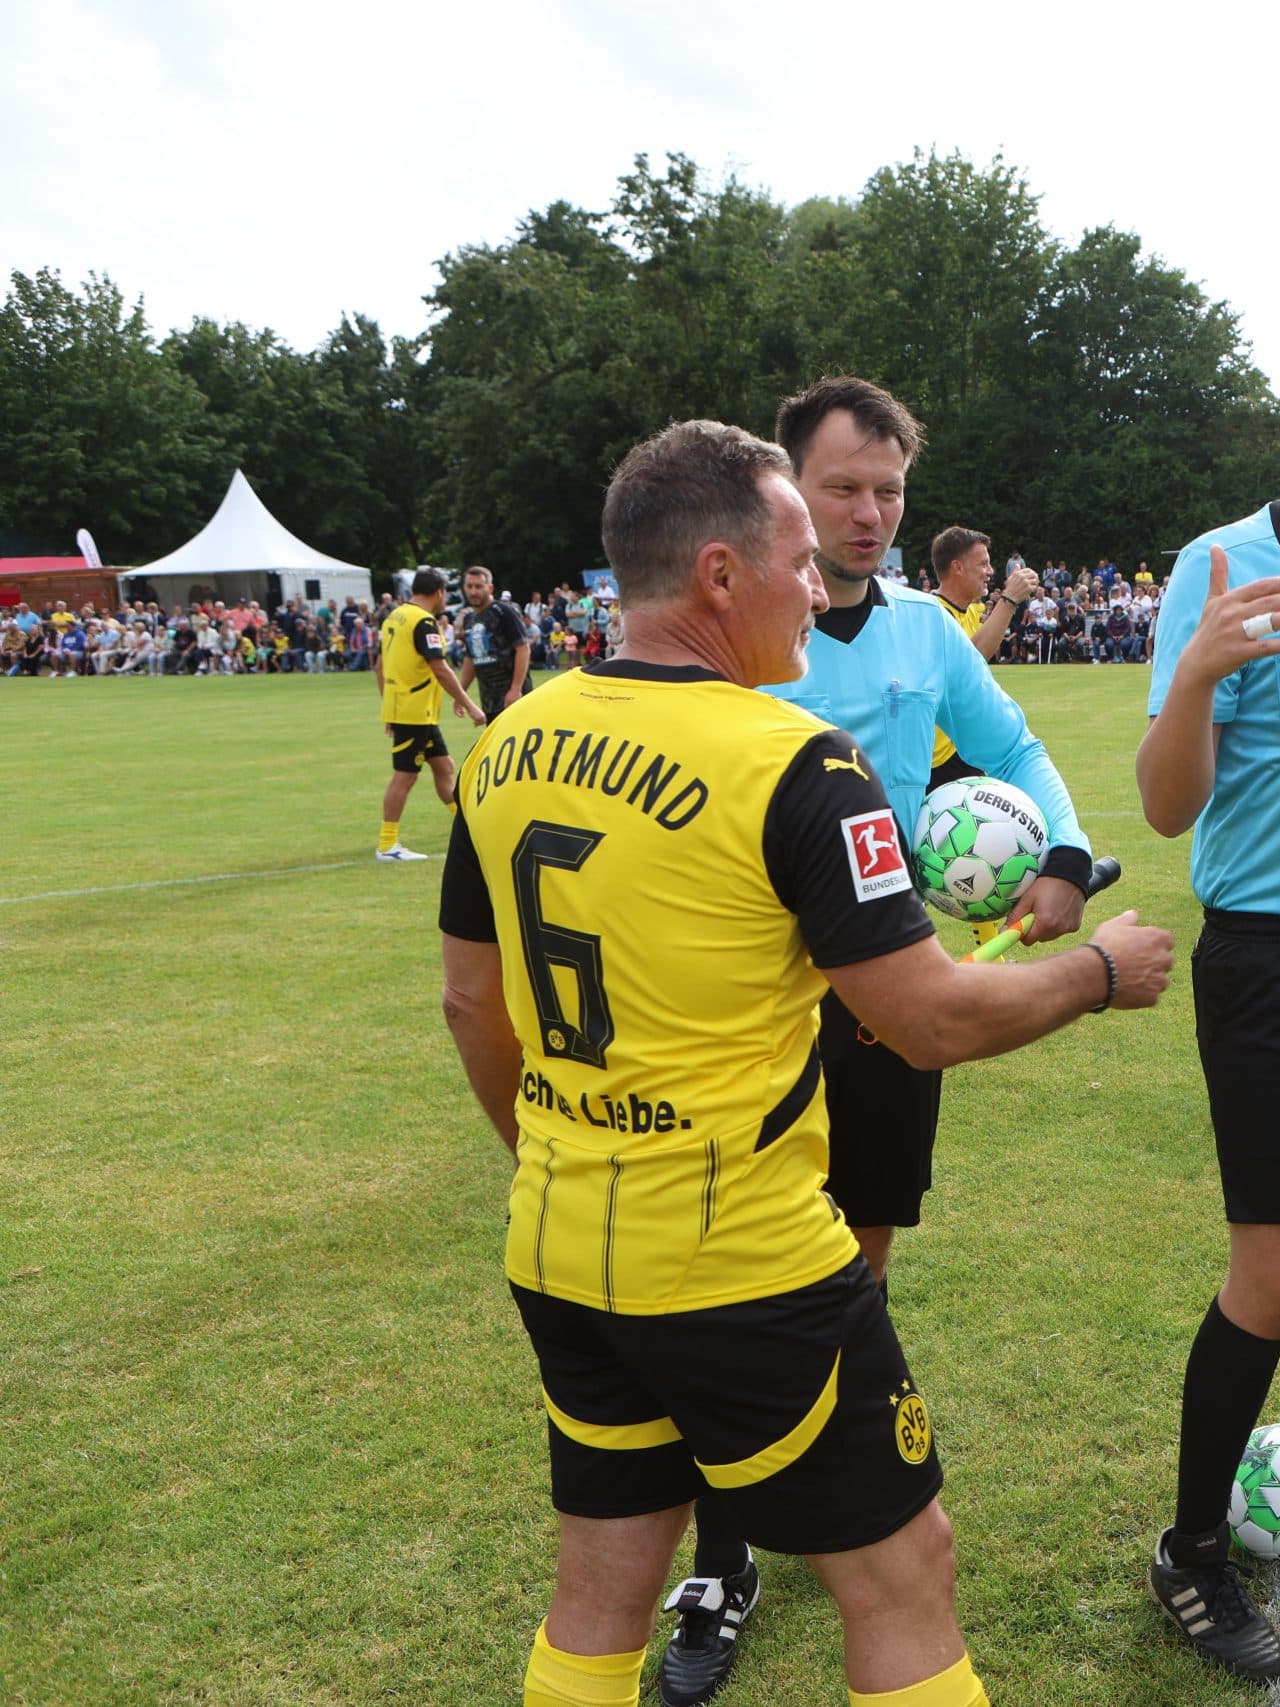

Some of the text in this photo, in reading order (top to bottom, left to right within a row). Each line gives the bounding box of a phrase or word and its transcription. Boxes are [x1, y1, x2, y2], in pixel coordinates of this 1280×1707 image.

[477, 728, 709, 831] DORTMUND
[973, 790, 1045, 847] DERBYSTAR
[862, 876, 908, 893] BUNDES
[953, 880, 974, 896] SELECT
[511, 819, 615, 1071] 6
[580, 1092, 692, 1134] Liebe.
[901, 1403, 926, 1452] BVB
